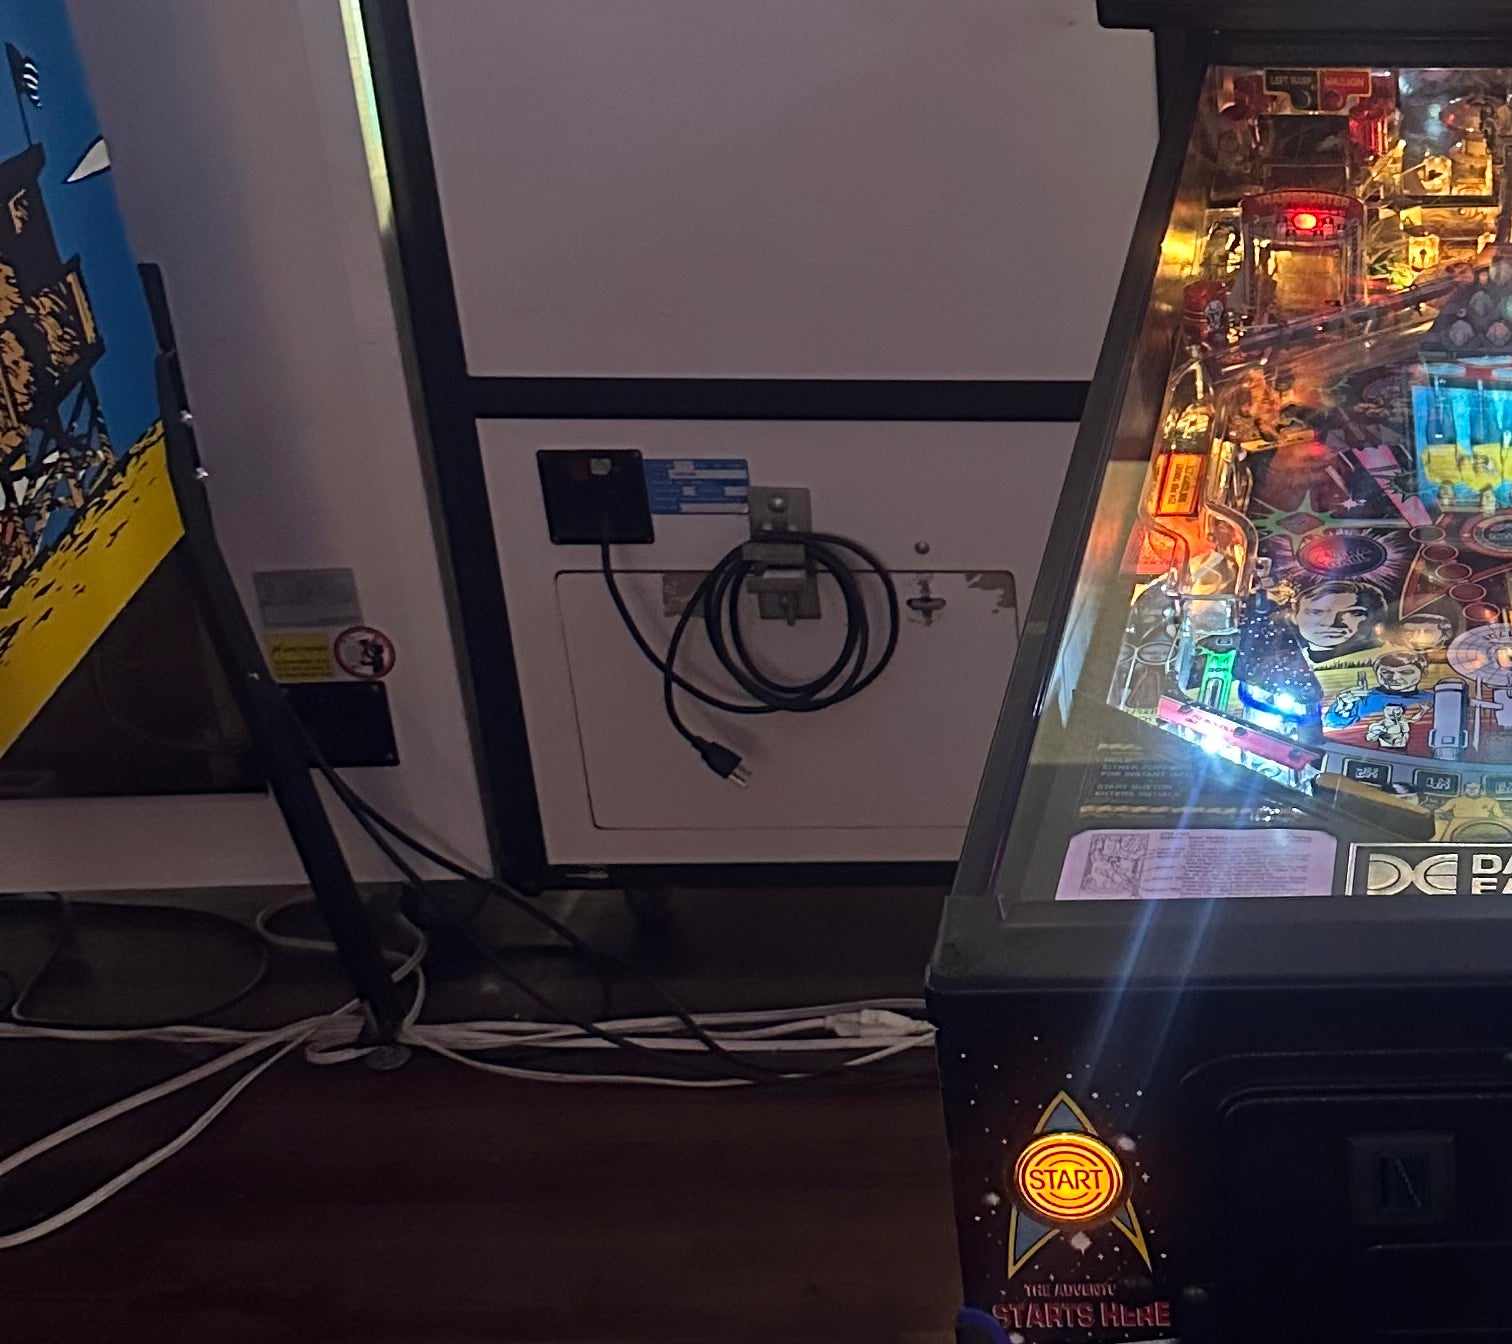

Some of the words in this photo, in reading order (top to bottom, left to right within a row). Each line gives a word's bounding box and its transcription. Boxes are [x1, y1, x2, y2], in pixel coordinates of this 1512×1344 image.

[1029, 1169, 1103, 1190] START
[992, 1304, 1095, 1329] STARTS
[1100, 1302, 1172, 1327] HERE
